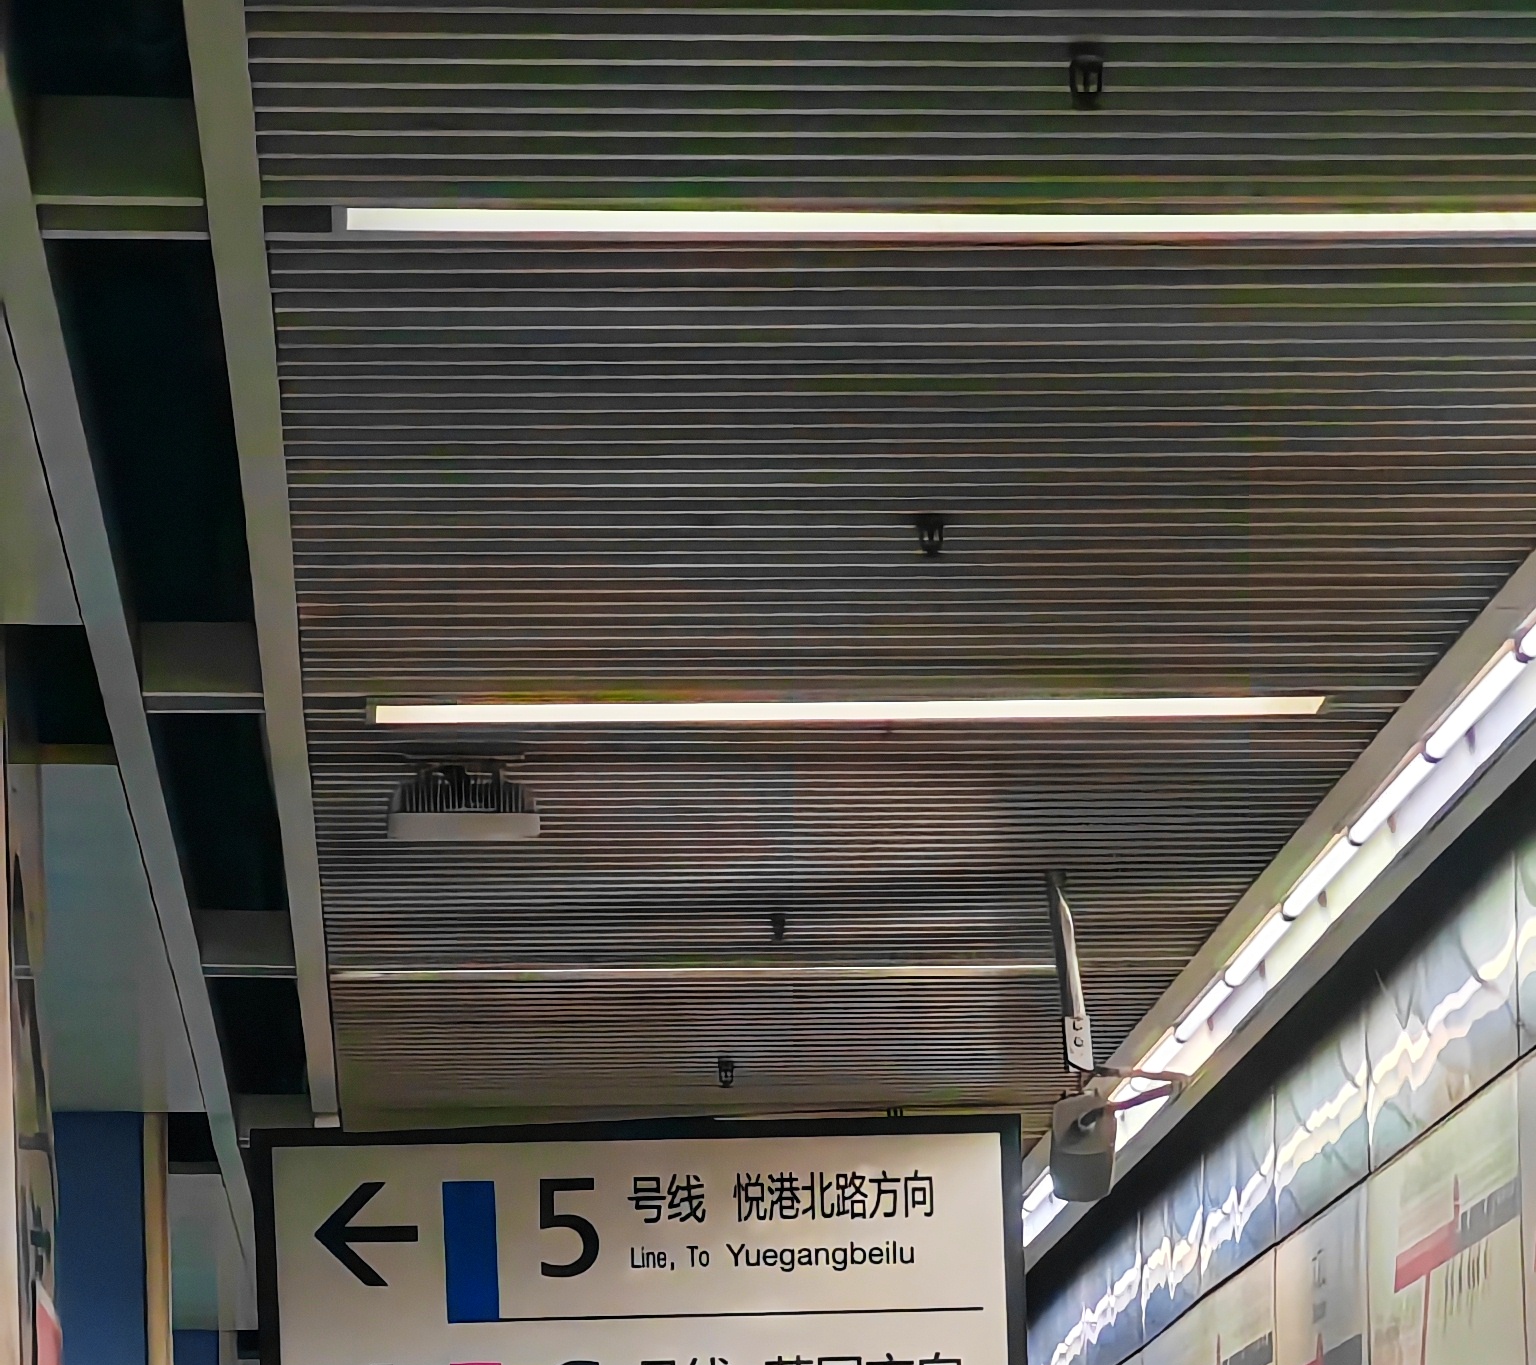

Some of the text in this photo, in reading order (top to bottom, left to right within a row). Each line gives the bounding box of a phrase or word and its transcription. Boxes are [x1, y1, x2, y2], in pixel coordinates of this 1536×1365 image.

[540, 1170, 936, 1278] 5 号线 悦港北路方向
[630, 1241, 916, 1273] Line, To Yuegangbeilu
